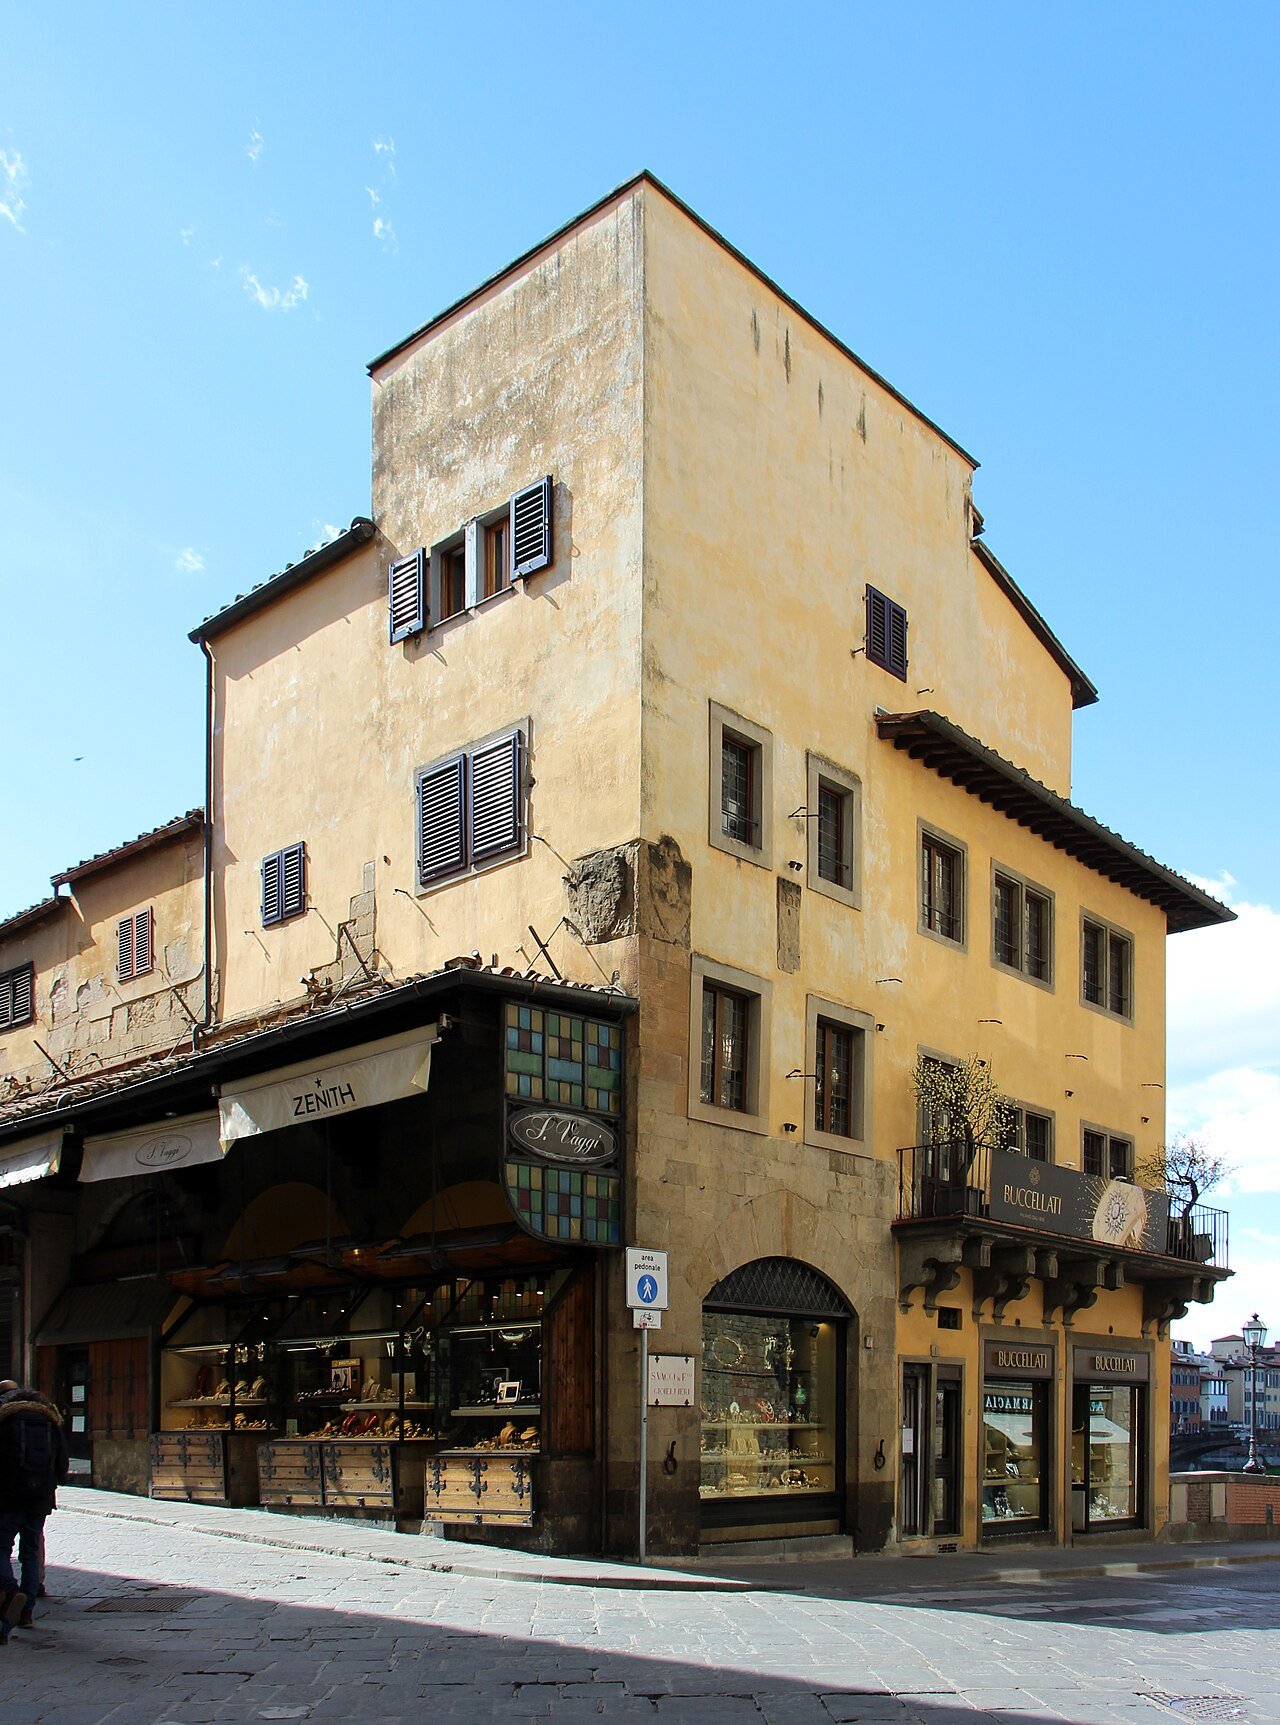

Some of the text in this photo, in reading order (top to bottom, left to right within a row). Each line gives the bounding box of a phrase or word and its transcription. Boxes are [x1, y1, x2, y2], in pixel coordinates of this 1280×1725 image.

[293, 1083, 356, 1116] ZENITH
[556, 1119, 602, 1154] Vaggi
[1003, 1184, 1062, 1215] BUCCELLATI
[634, 1263, 661, 1271] pedonale
[641, 1254, 654, 1262] area
[998, 1350, 1047, 1369] BUCCELLATI
[1095, 1355, 1136, 1372] BUCCELLATI
